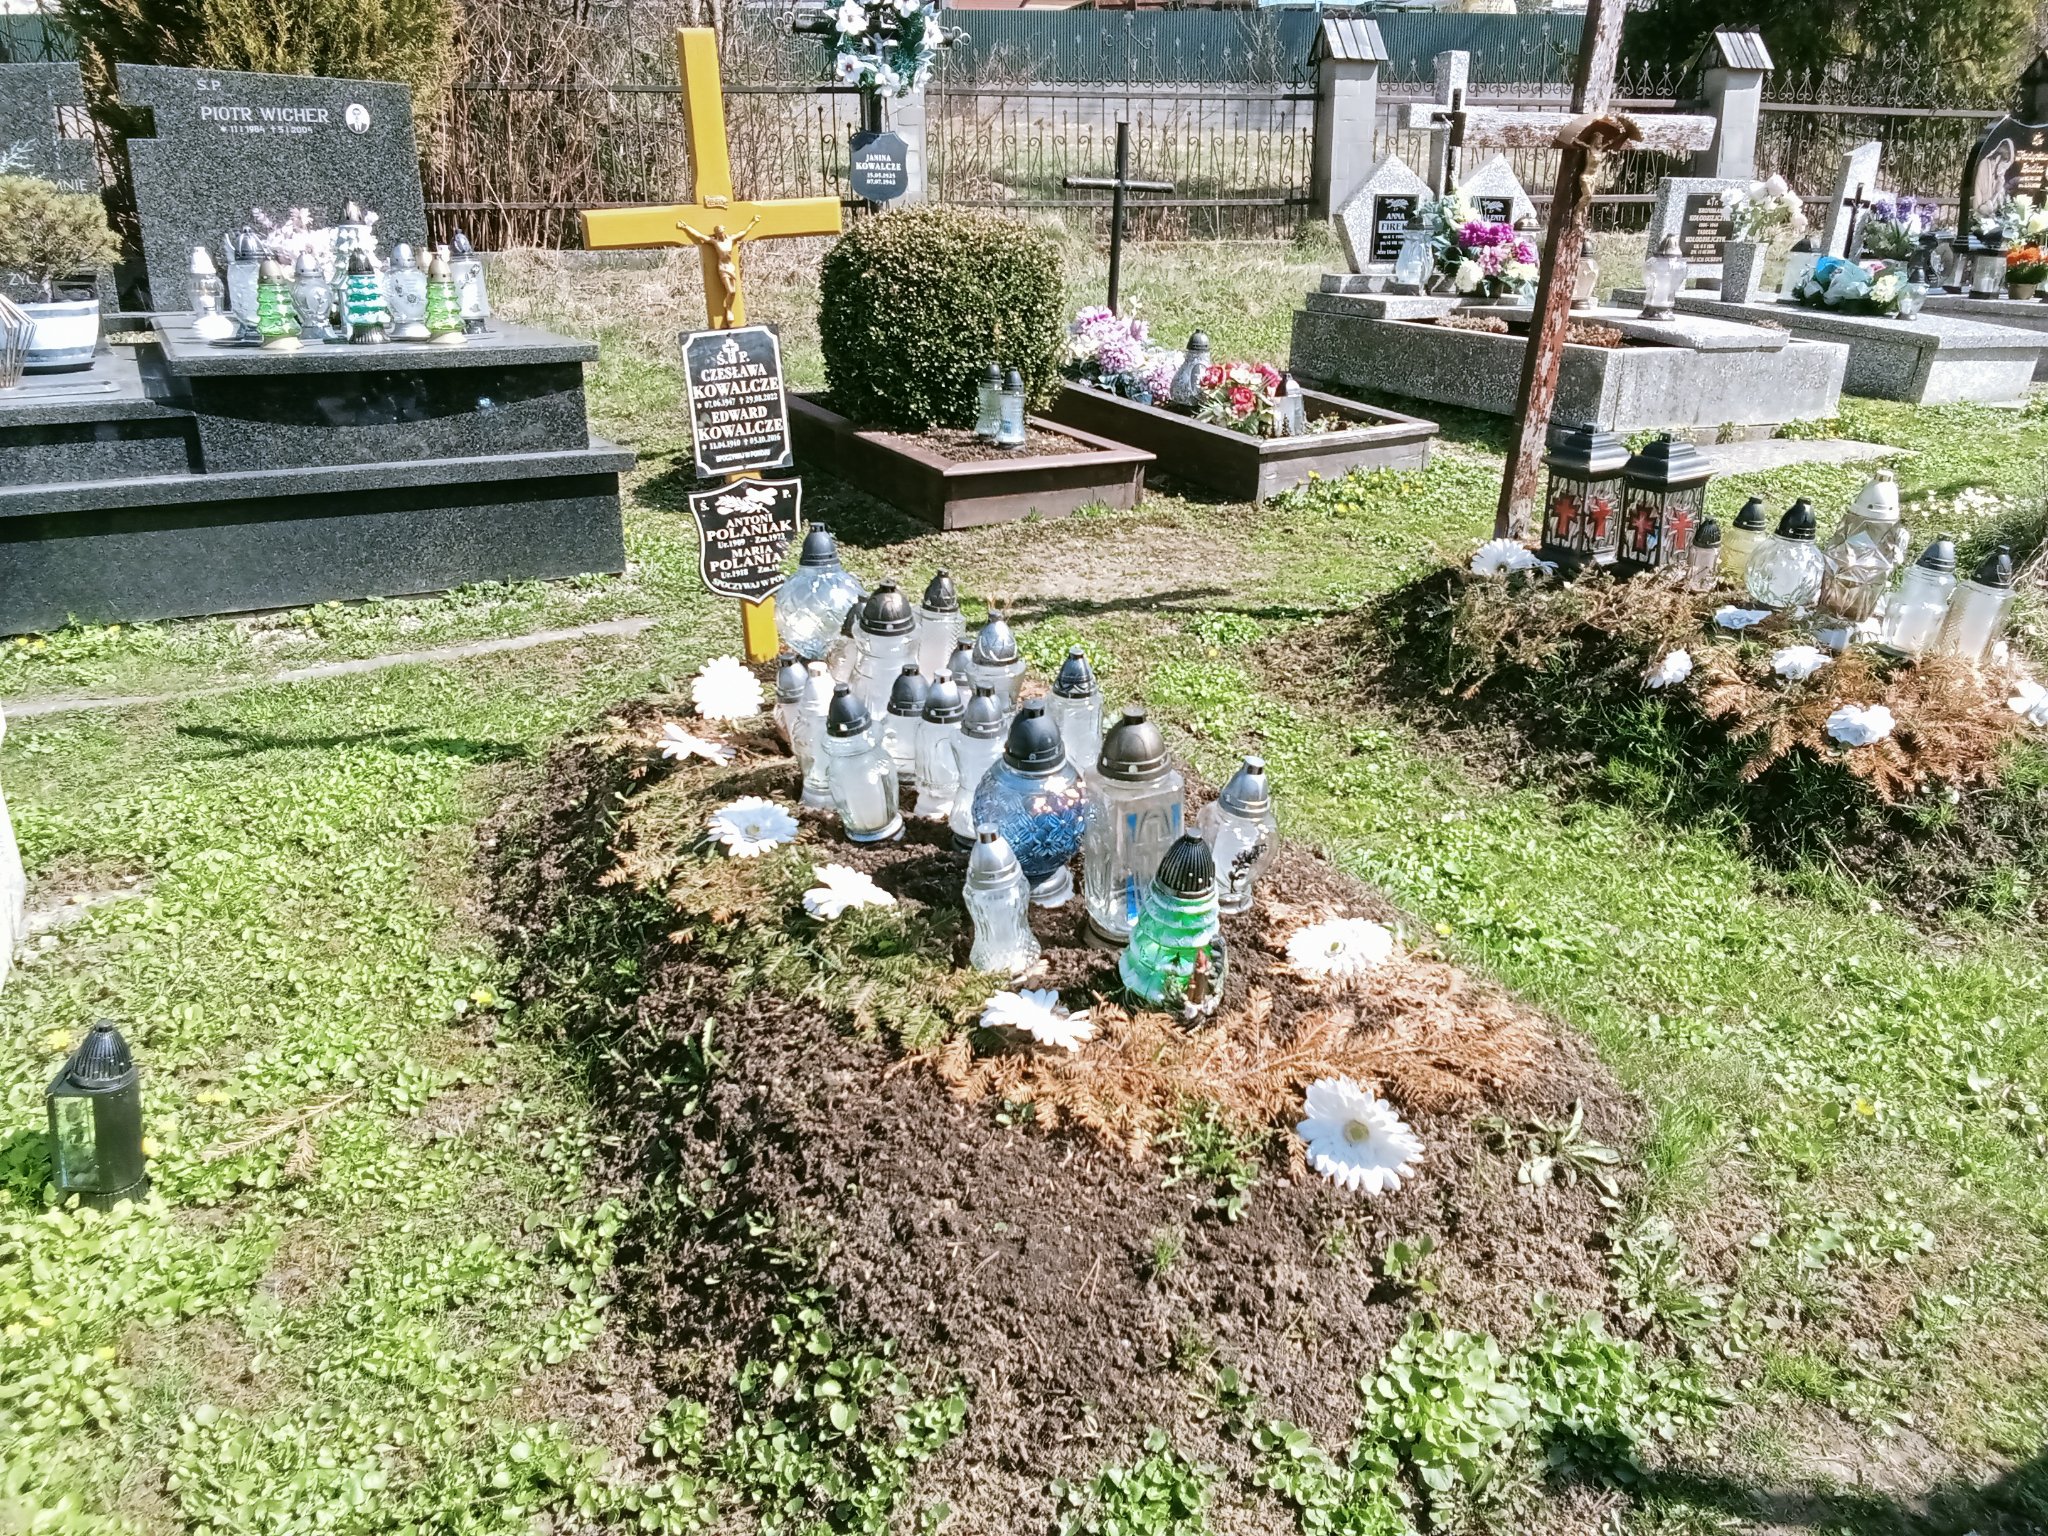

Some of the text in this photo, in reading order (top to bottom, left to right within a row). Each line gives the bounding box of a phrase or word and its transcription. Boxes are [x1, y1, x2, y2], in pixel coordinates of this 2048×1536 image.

[200, 106, 330, 123] PIOTR WICHER
[855, 161, 902, 171] KOWALCZE
[865, 153, 892, 162] JANINA
[701, 363, 768, 382] CZESŁAWA
[693, 377, 780, 400] KOWALCZE
[711, 406, 768, 424] EDWARD
[698, 418, 784, 441] KOWALCZE
[726, 513, 774, 529] ANTONI
[706, 520, 793, 542] POLANIAK
[731, 544, 774, 559] MARIA
[709, 552, 785, 573] POLANIA
